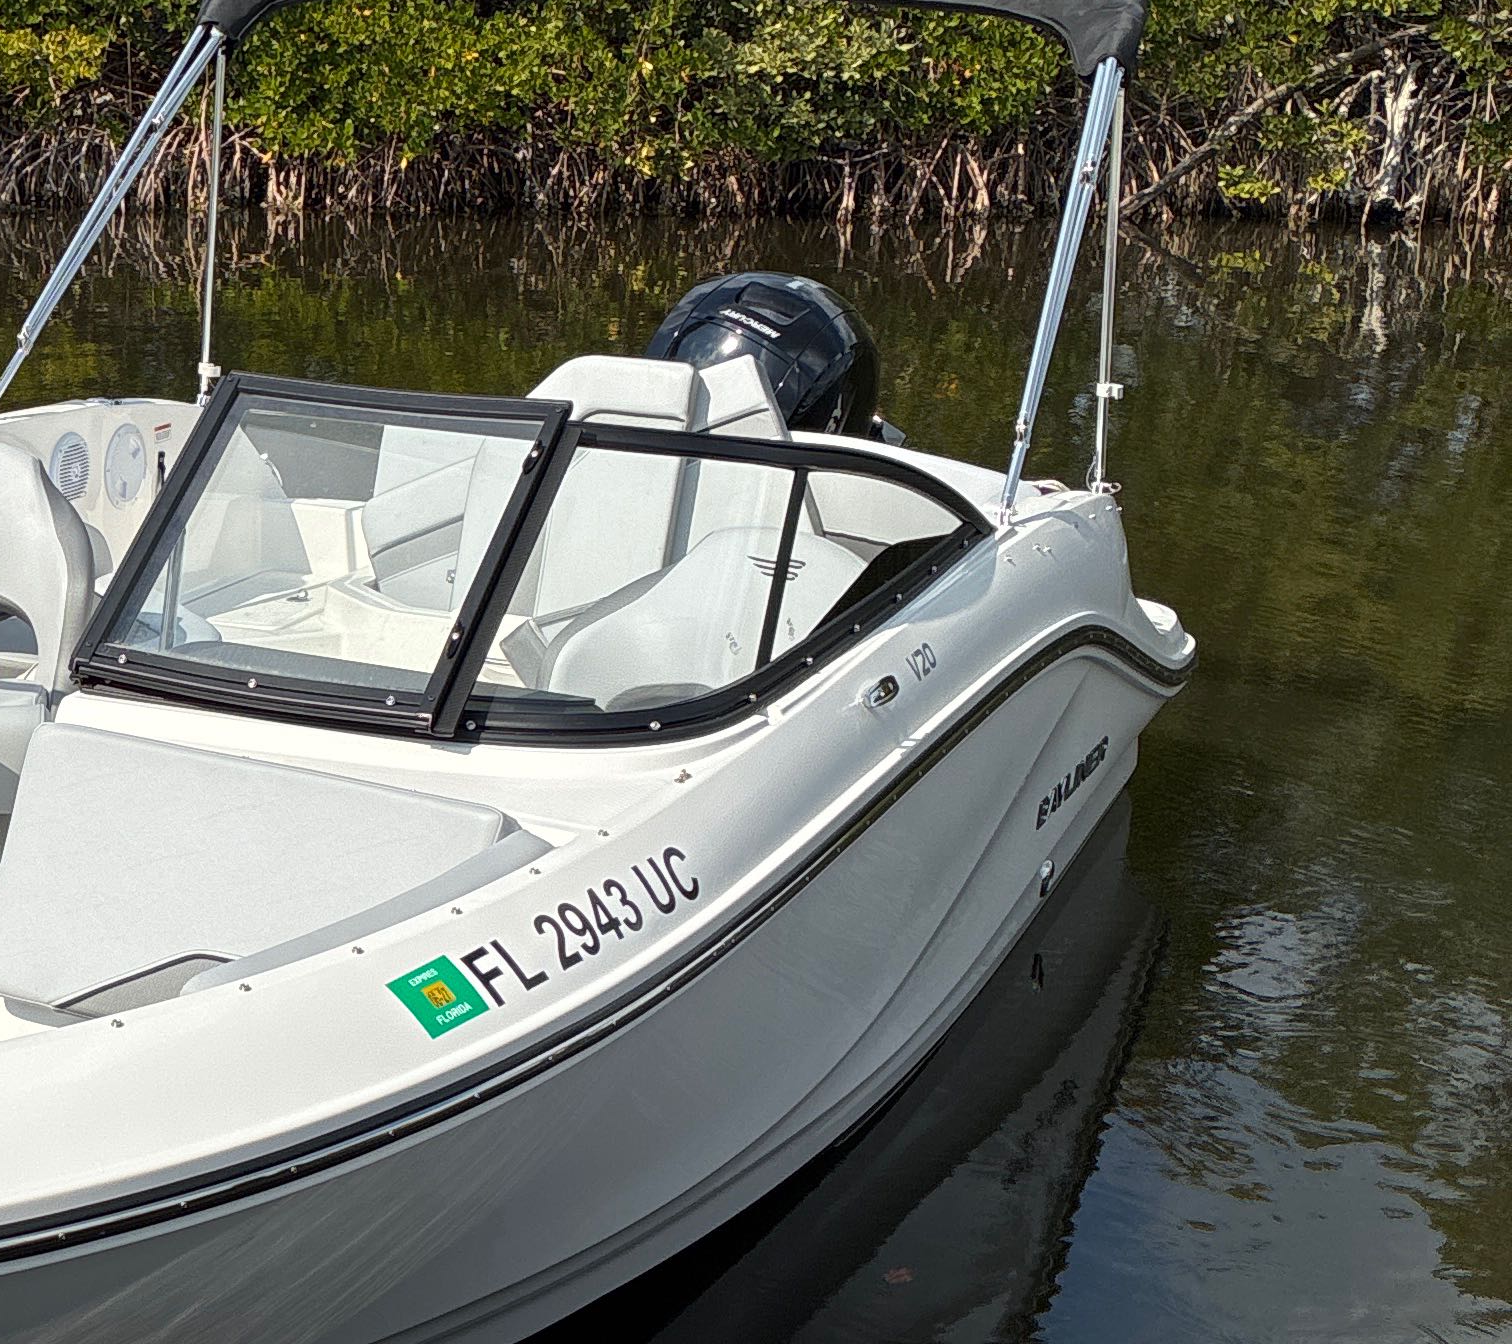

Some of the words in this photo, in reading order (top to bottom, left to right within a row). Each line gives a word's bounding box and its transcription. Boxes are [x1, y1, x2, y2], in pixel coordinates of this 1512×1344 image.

[719, 309, 782, 338] MERCURY
[905, 642, 937, 681] V20
[460, 939, 550, 1007] FL
[533, 879, 643, 971] 2943
[630, 846, 700, 914] UC
[435, 1001, 473, 1026] FLORIDA
